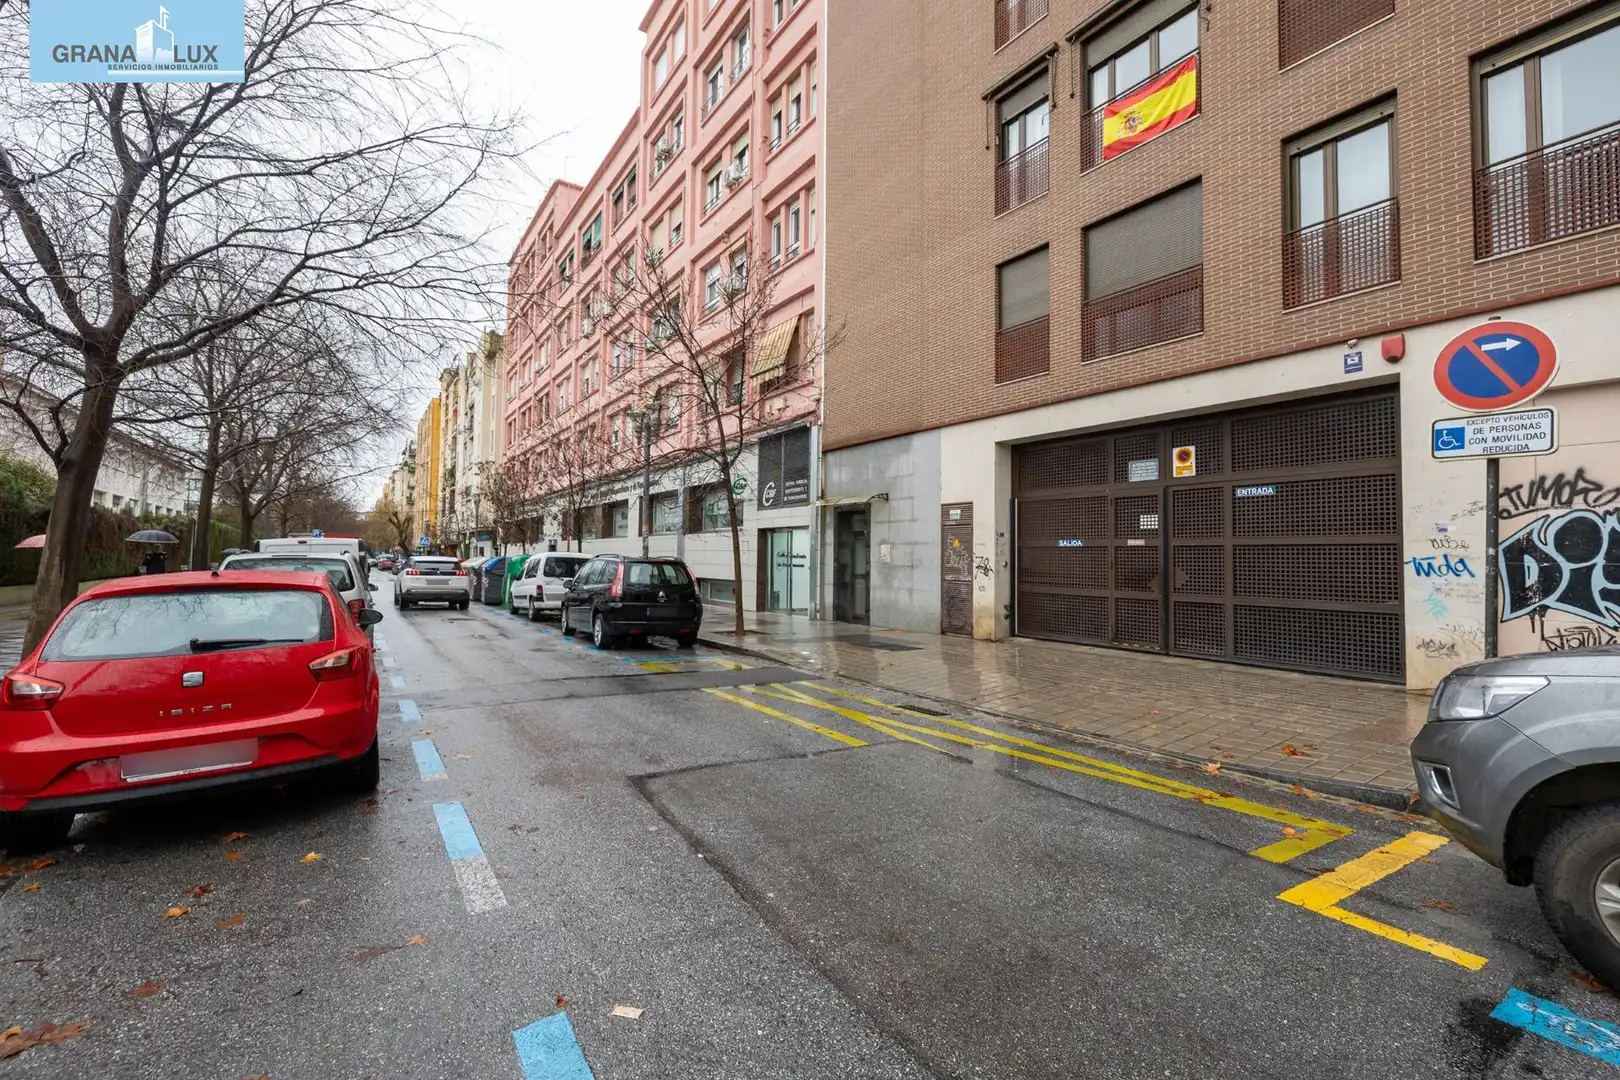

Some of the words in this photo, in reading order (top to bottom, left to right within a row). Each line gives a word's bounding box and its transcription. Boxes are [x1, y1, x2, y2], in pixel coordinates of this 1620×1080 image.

[1466, 417, 1501, 426] EXCEPTO
[1472, 427, 1485, 435] DE
[1489, 421, 1542, 434] PERSONAS
[1468, 436, 1488, 445] CON
[1491, 431, 1547, 444] MOVILIDAD
[1482, 443, 1530, 454] REDUCIDA
[1236, 486, 1274, 497] ENTRADA
[1059, 539, 1082, 547] SALIDA
[159, 703, 232, 717] IBIZA
